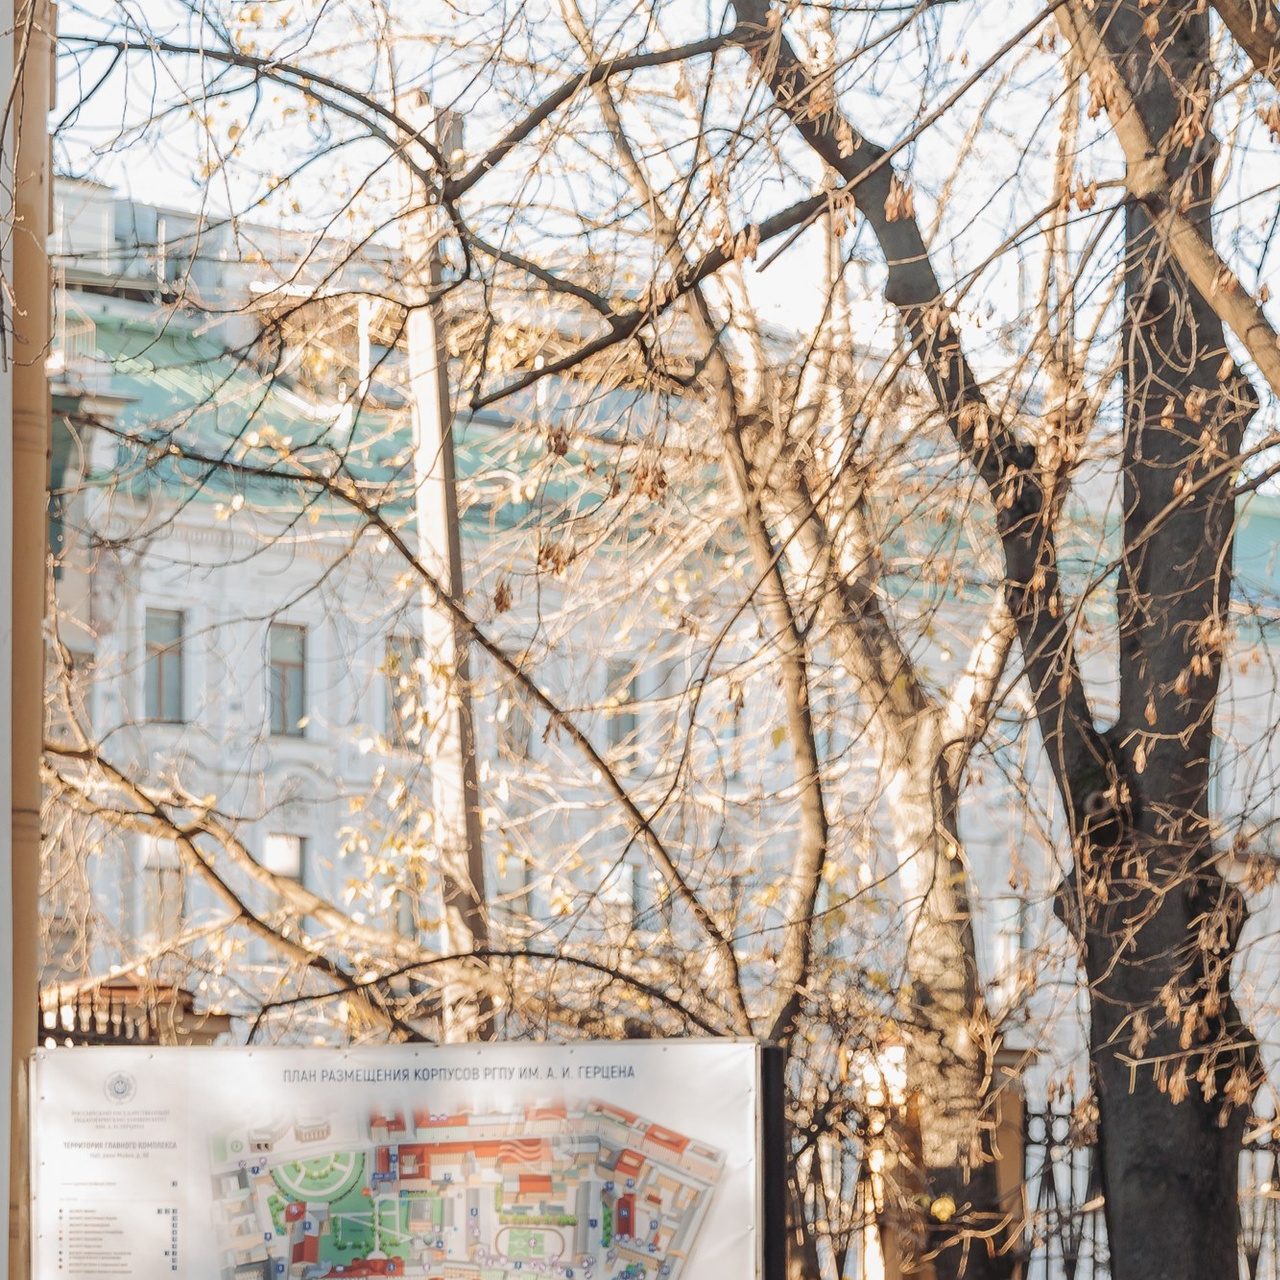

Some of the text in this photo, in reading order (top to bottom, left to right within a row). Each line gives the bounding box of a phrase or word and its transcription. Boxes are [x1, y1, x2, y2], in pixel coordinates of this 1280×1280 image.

[283, 1065, 636, 1084] ПЛАН РАЗМЕЩЕНИЯ КОРПУСОВ РГПУ ИМ. А. И. ГЕРЦЕНА
